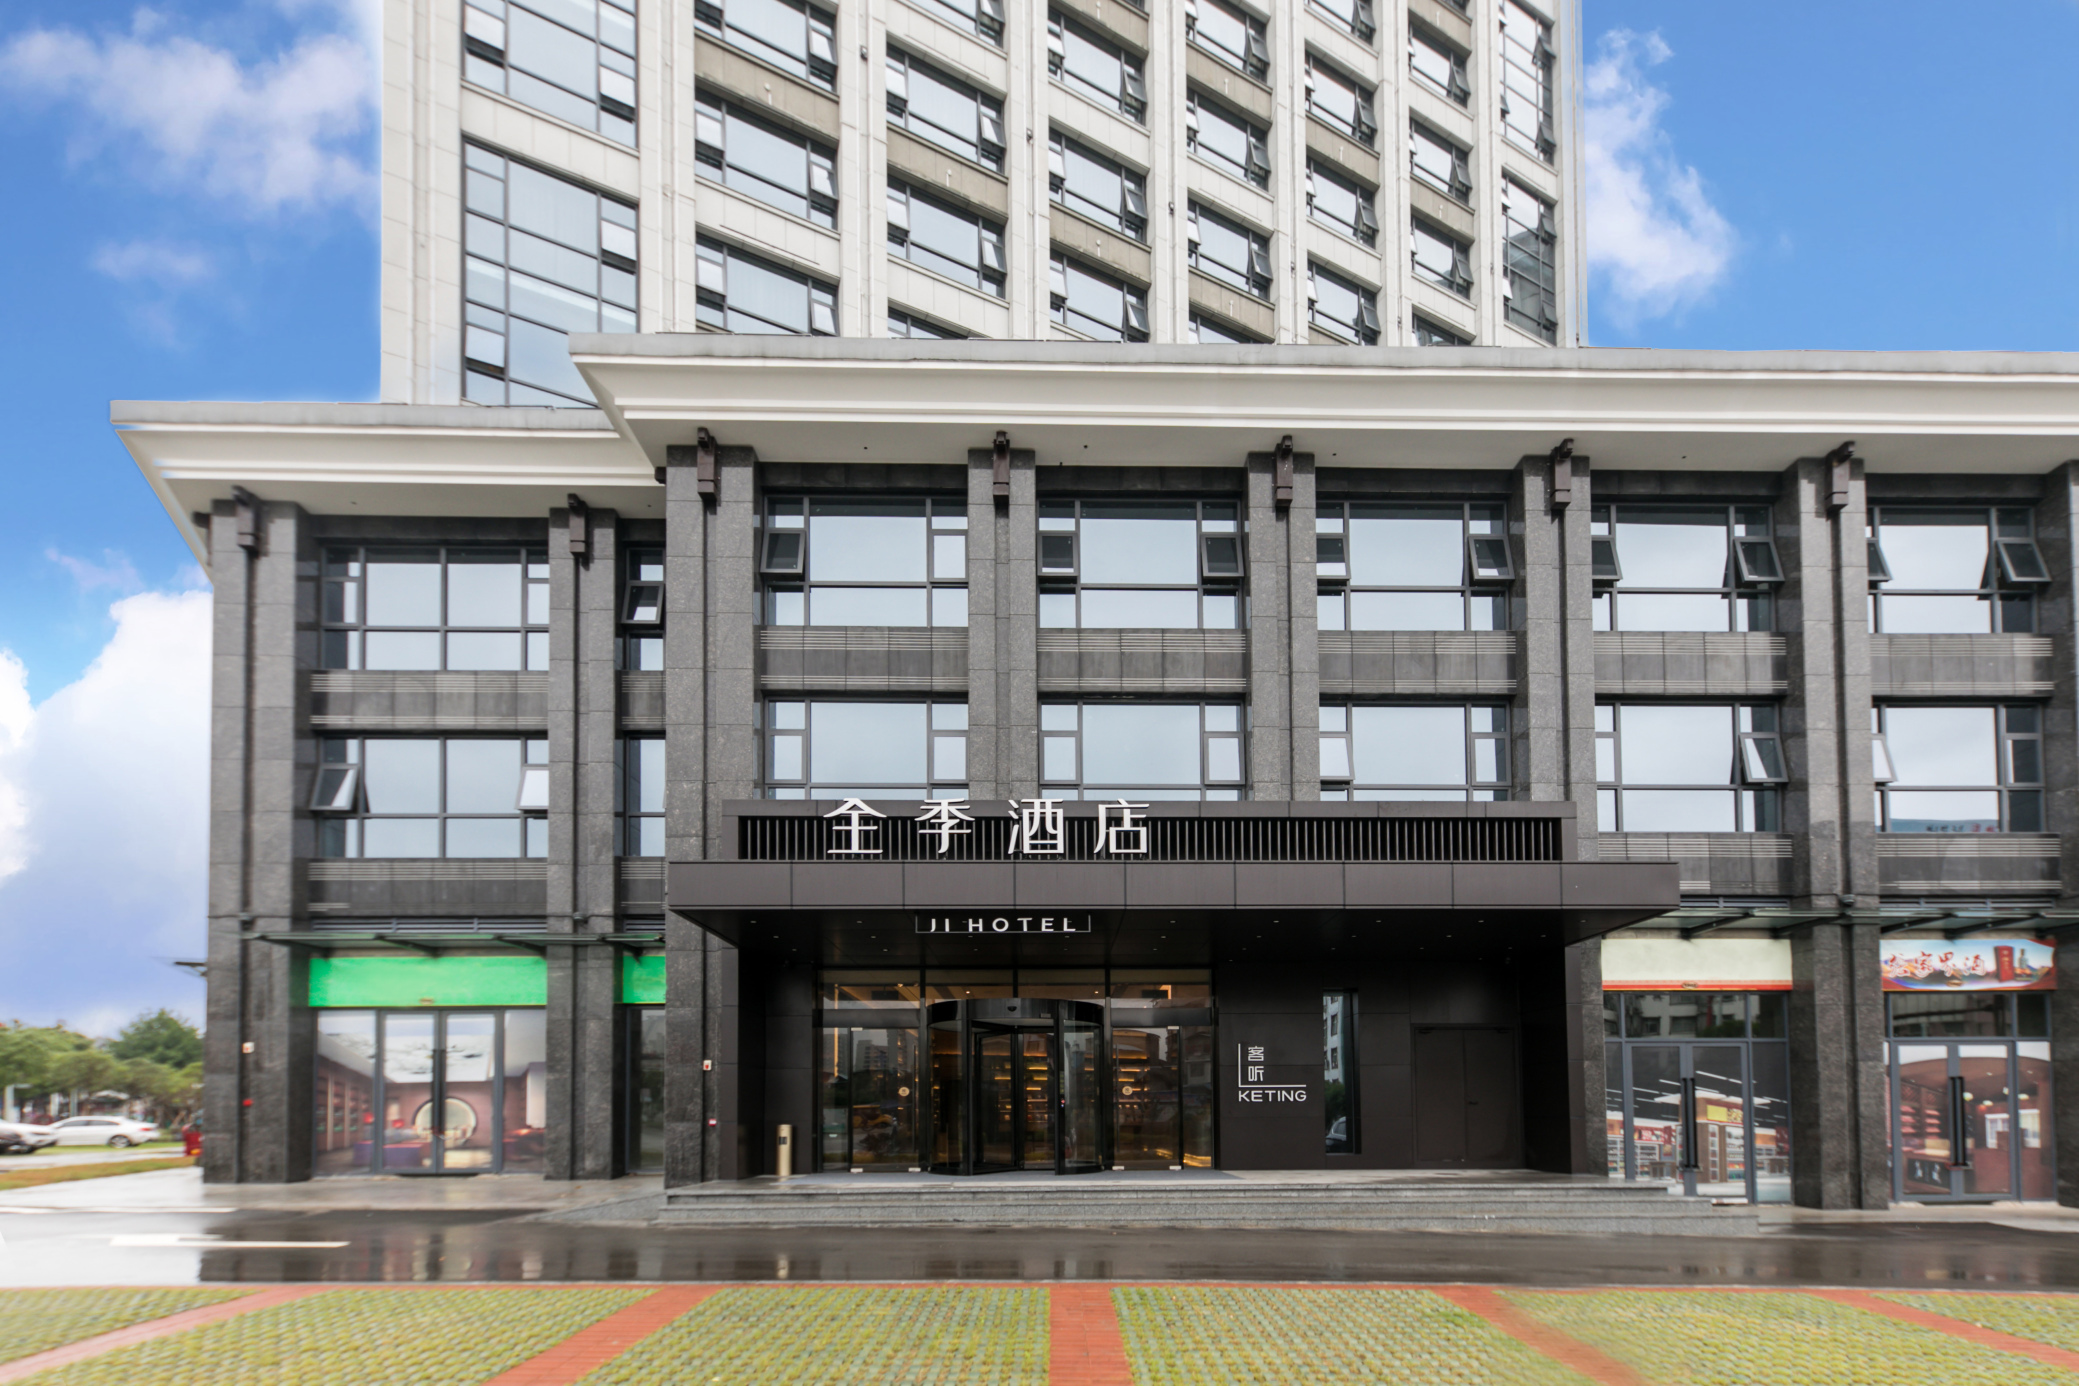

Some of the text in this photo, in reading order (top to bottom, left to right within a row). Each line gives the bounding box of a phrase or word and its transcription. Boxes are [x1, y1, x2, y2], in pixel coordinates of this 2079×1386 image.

[823, 798, 1150, 855] 全季酒店
[930, 917, 1076, 933] JI HOTEL
[1247, 1045, 1264, 1082] 客听
[1238, 1090, 1307, 1102] KETING
